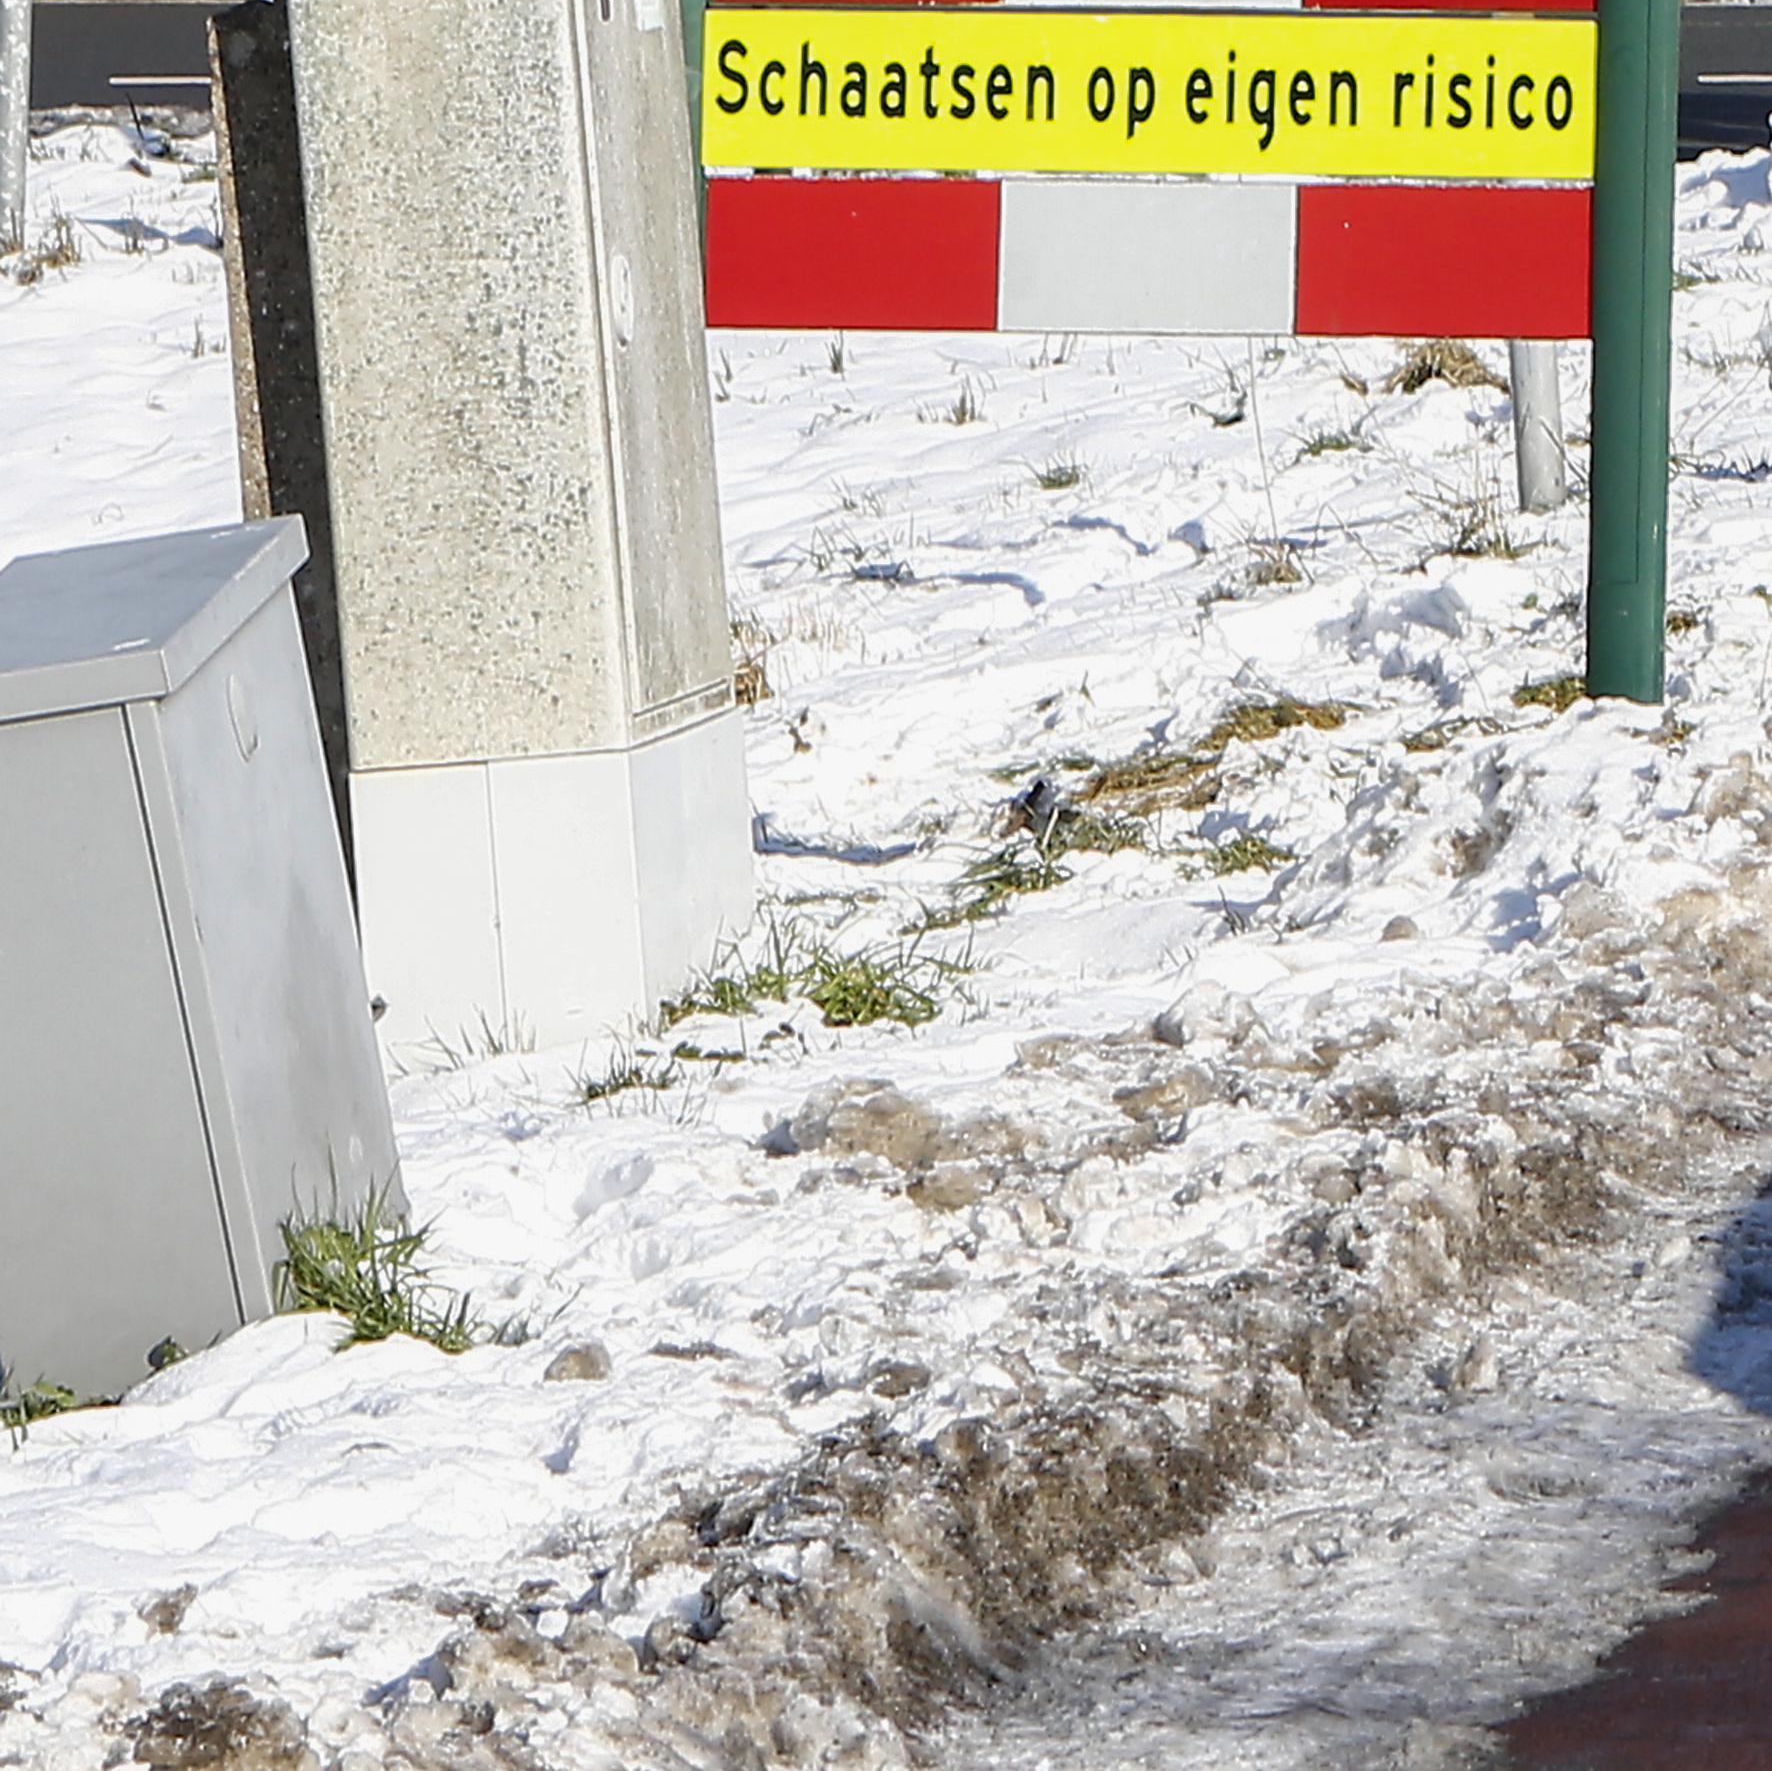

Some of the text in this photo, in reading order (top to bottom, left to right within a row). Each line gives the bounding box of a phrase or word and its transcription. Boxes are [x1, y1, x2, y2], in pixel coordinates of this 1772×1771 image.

[714, 38, 1574, 152] Schaatsen op eigen risico
